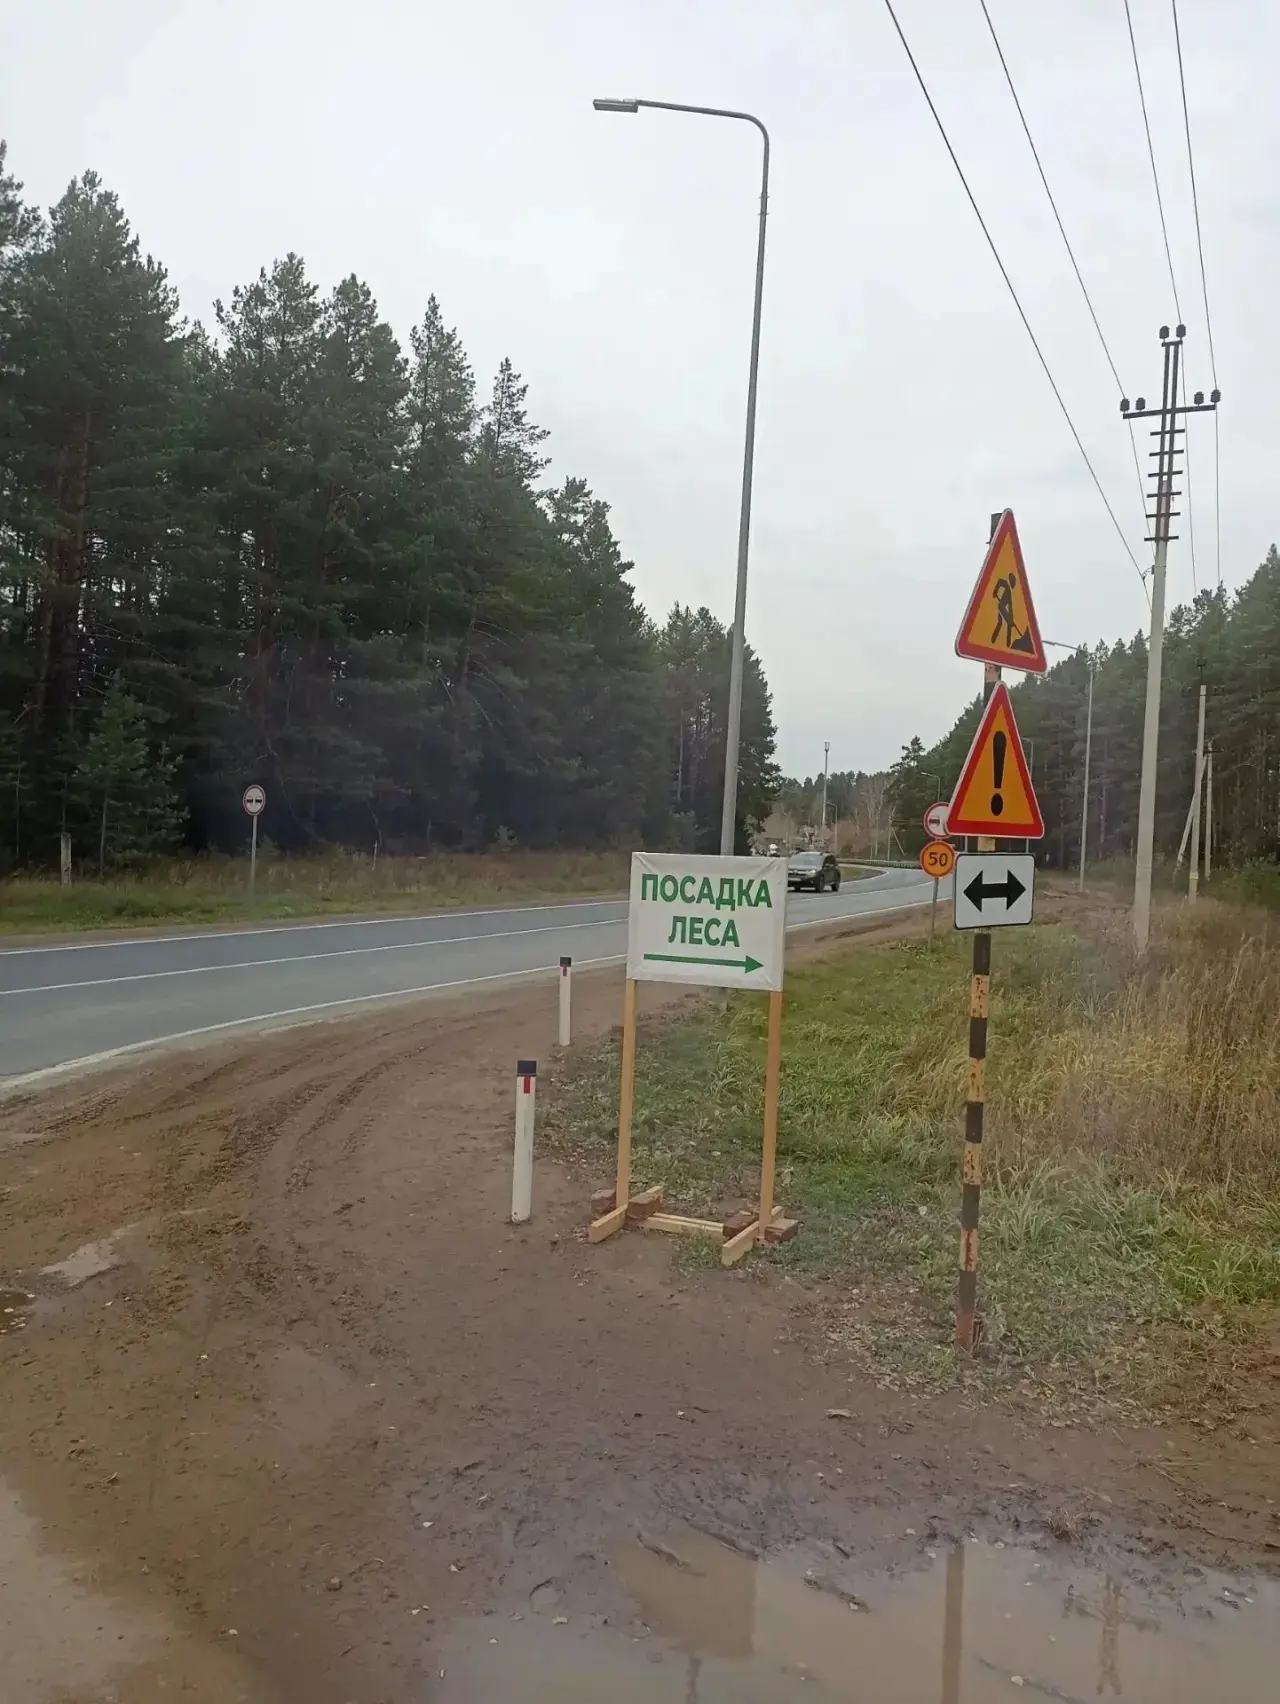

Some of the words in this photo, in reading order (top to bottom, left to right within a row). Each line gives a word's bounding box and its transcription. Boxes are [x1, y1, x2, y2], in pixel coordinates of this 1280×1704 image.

[928, 851, 948, 867] 50
[641, 873, 773, 911] ПОСАДКА
[668, 915, 740, 947] ЛЕСА
